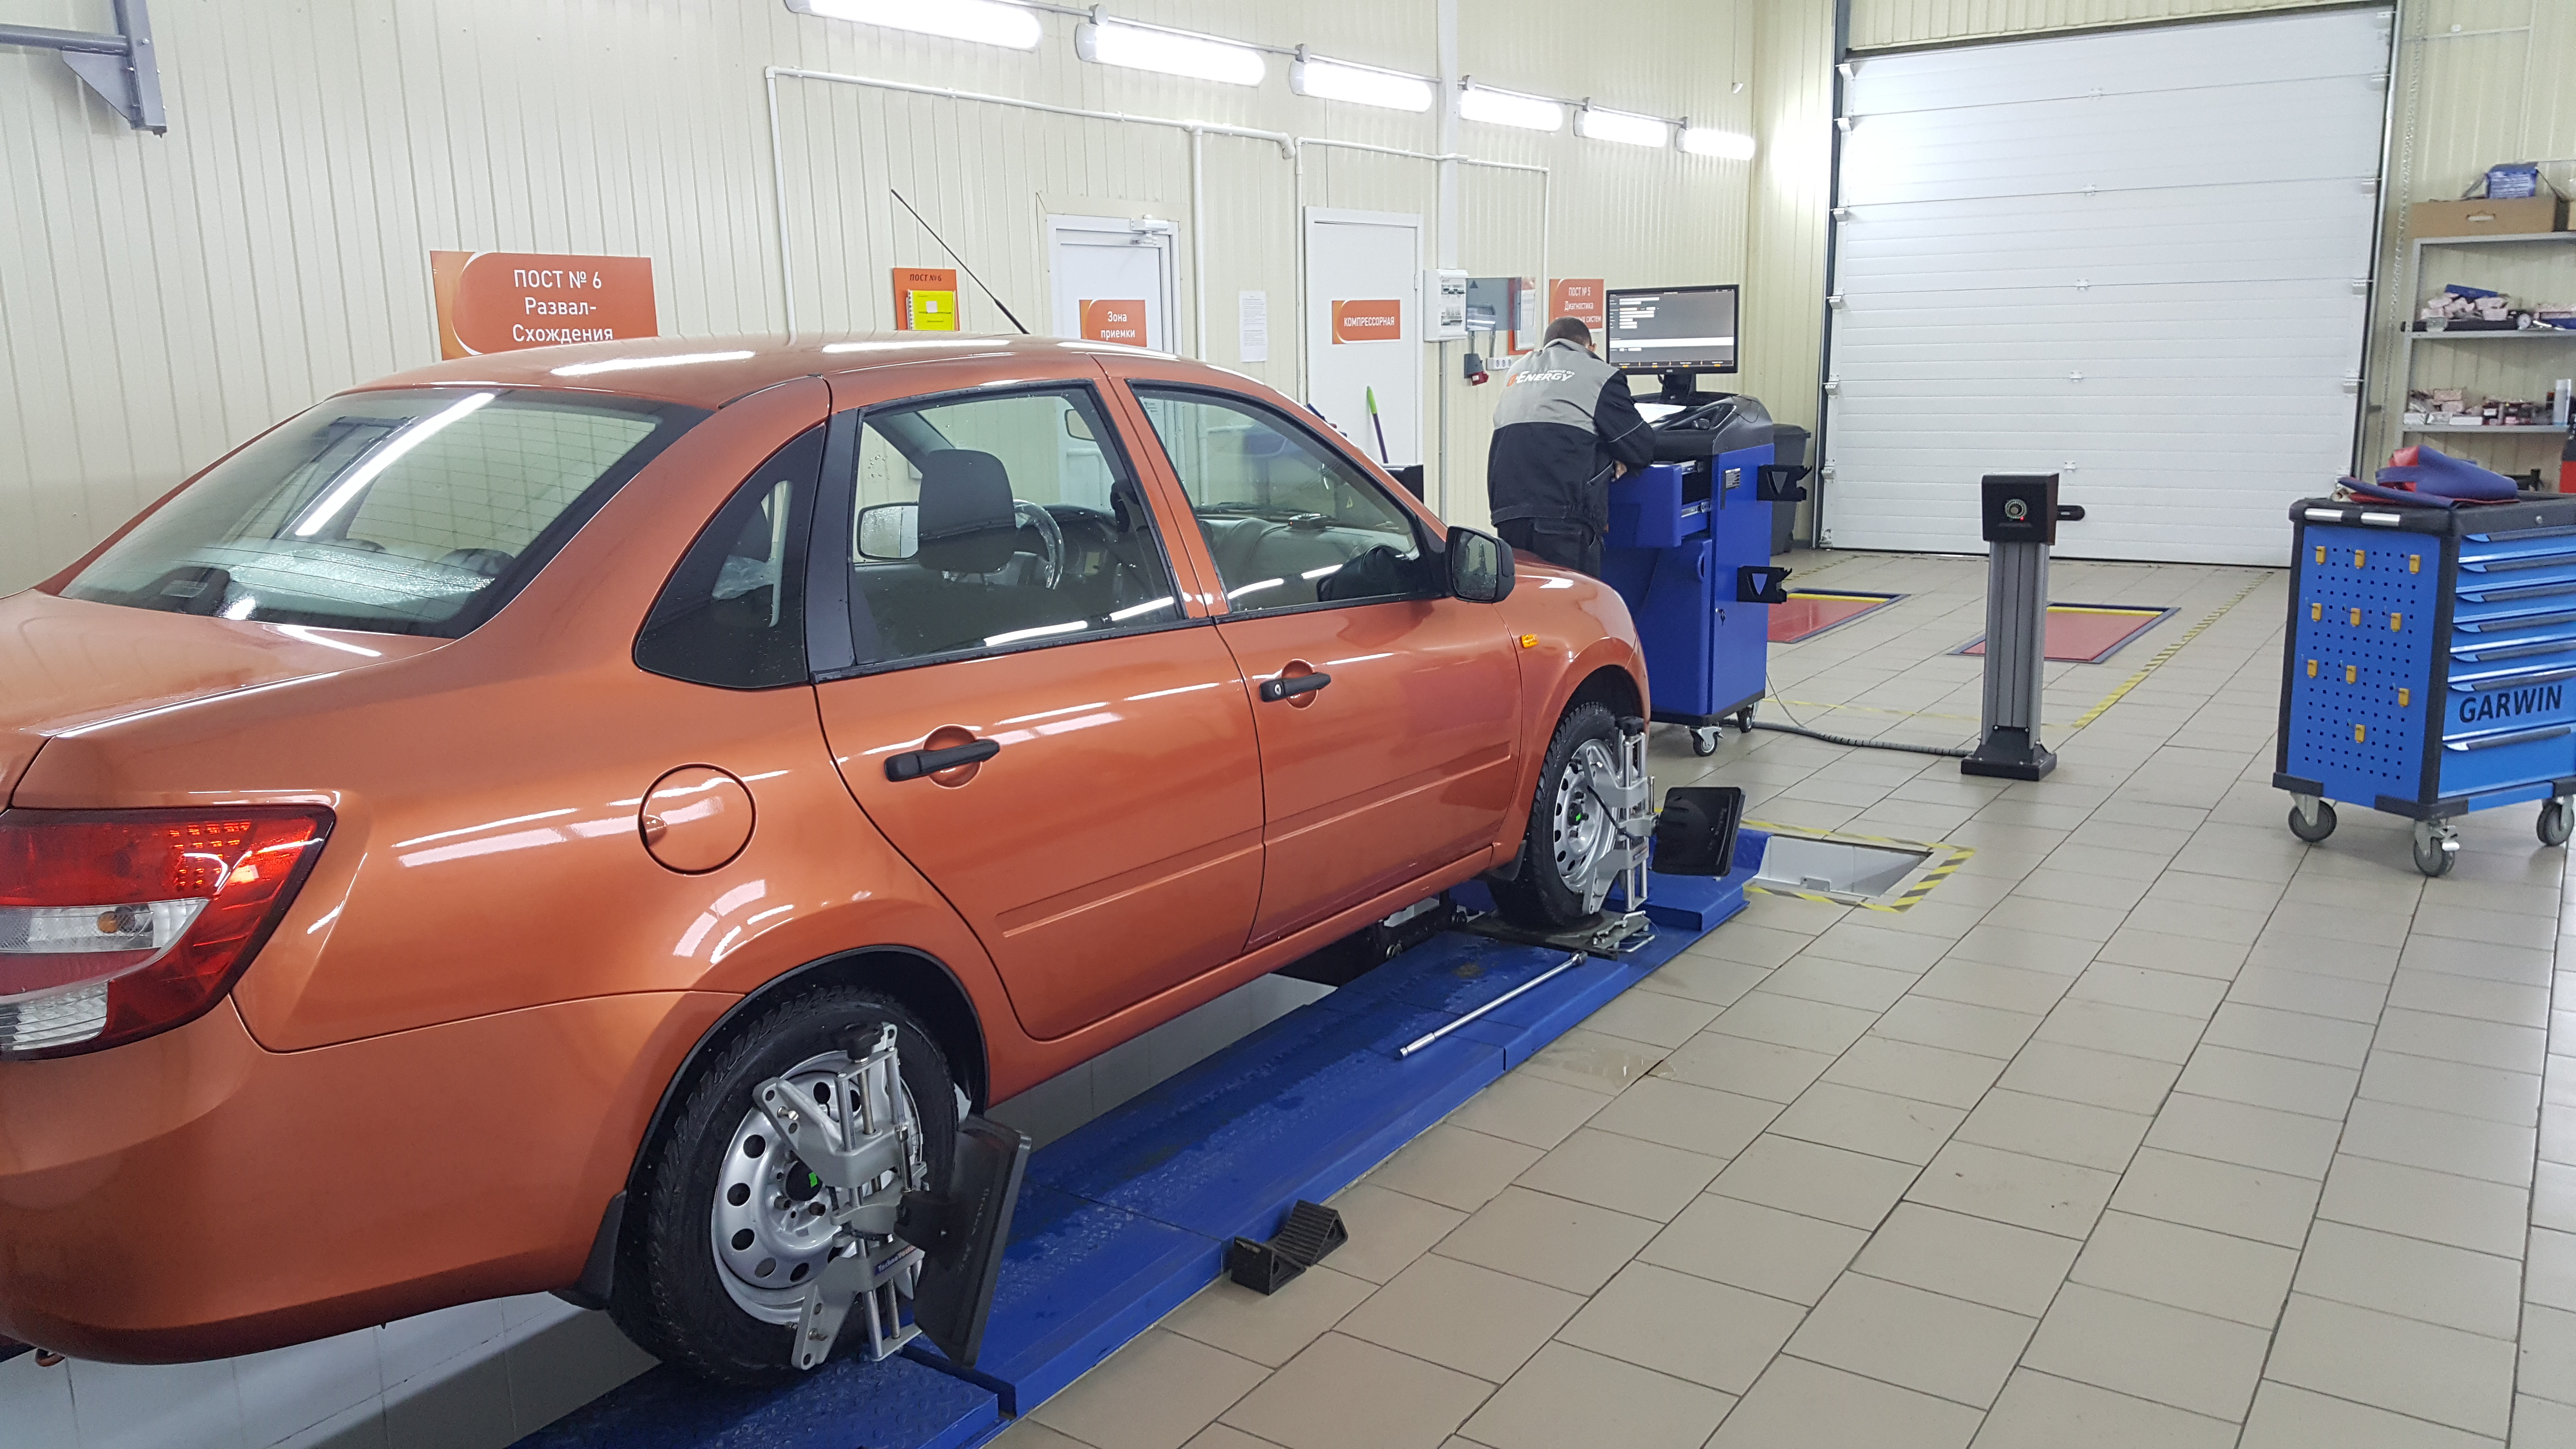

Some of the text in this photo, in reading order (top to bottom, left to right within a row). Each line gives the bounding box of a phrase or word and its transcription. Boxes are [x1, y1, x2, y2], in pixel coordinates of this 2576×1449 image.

[514, 270, 602, 289] ПОСТ № 6
[1569, 287, 1581, 296] ПОСТ
[525, 297, 597, 315] Развал-
[1564, 301, 1594, 311] Диагностика
[1107, 311, 1127, 322] Зона
[1344, 317, 1395, 326] КОМПРЕССОРНАЯ
[513, 323, 613, 344] Схождения
[1101, 329, 1135, 340] приемки
[2459, 685, 2562, 723] GARWIN
